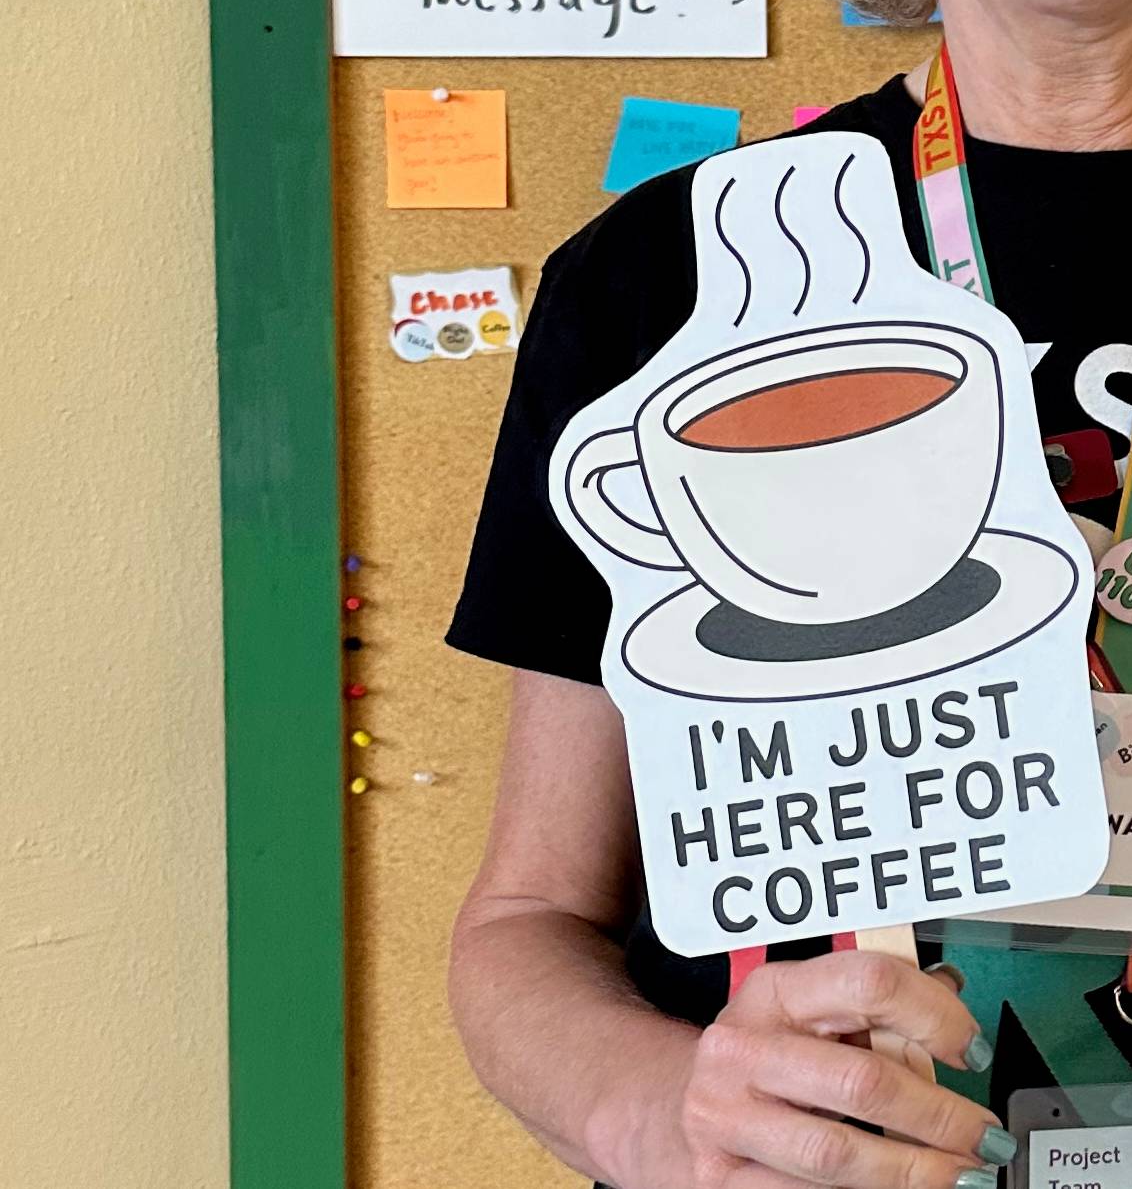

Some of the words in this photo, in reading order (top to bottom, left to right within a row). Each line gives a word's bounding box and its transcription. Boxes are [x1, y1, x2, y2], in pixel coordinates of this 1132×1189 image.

[689, 719, 793, 791] I'M
[829, 681, 1018, 767] JUST
[671, 782, 872, 867] HERE
[906, 752, 1060, 830] FOR
[712, 834, 1011, 933] COFFEE
[1049, 1147, 1121, 1170] Project
